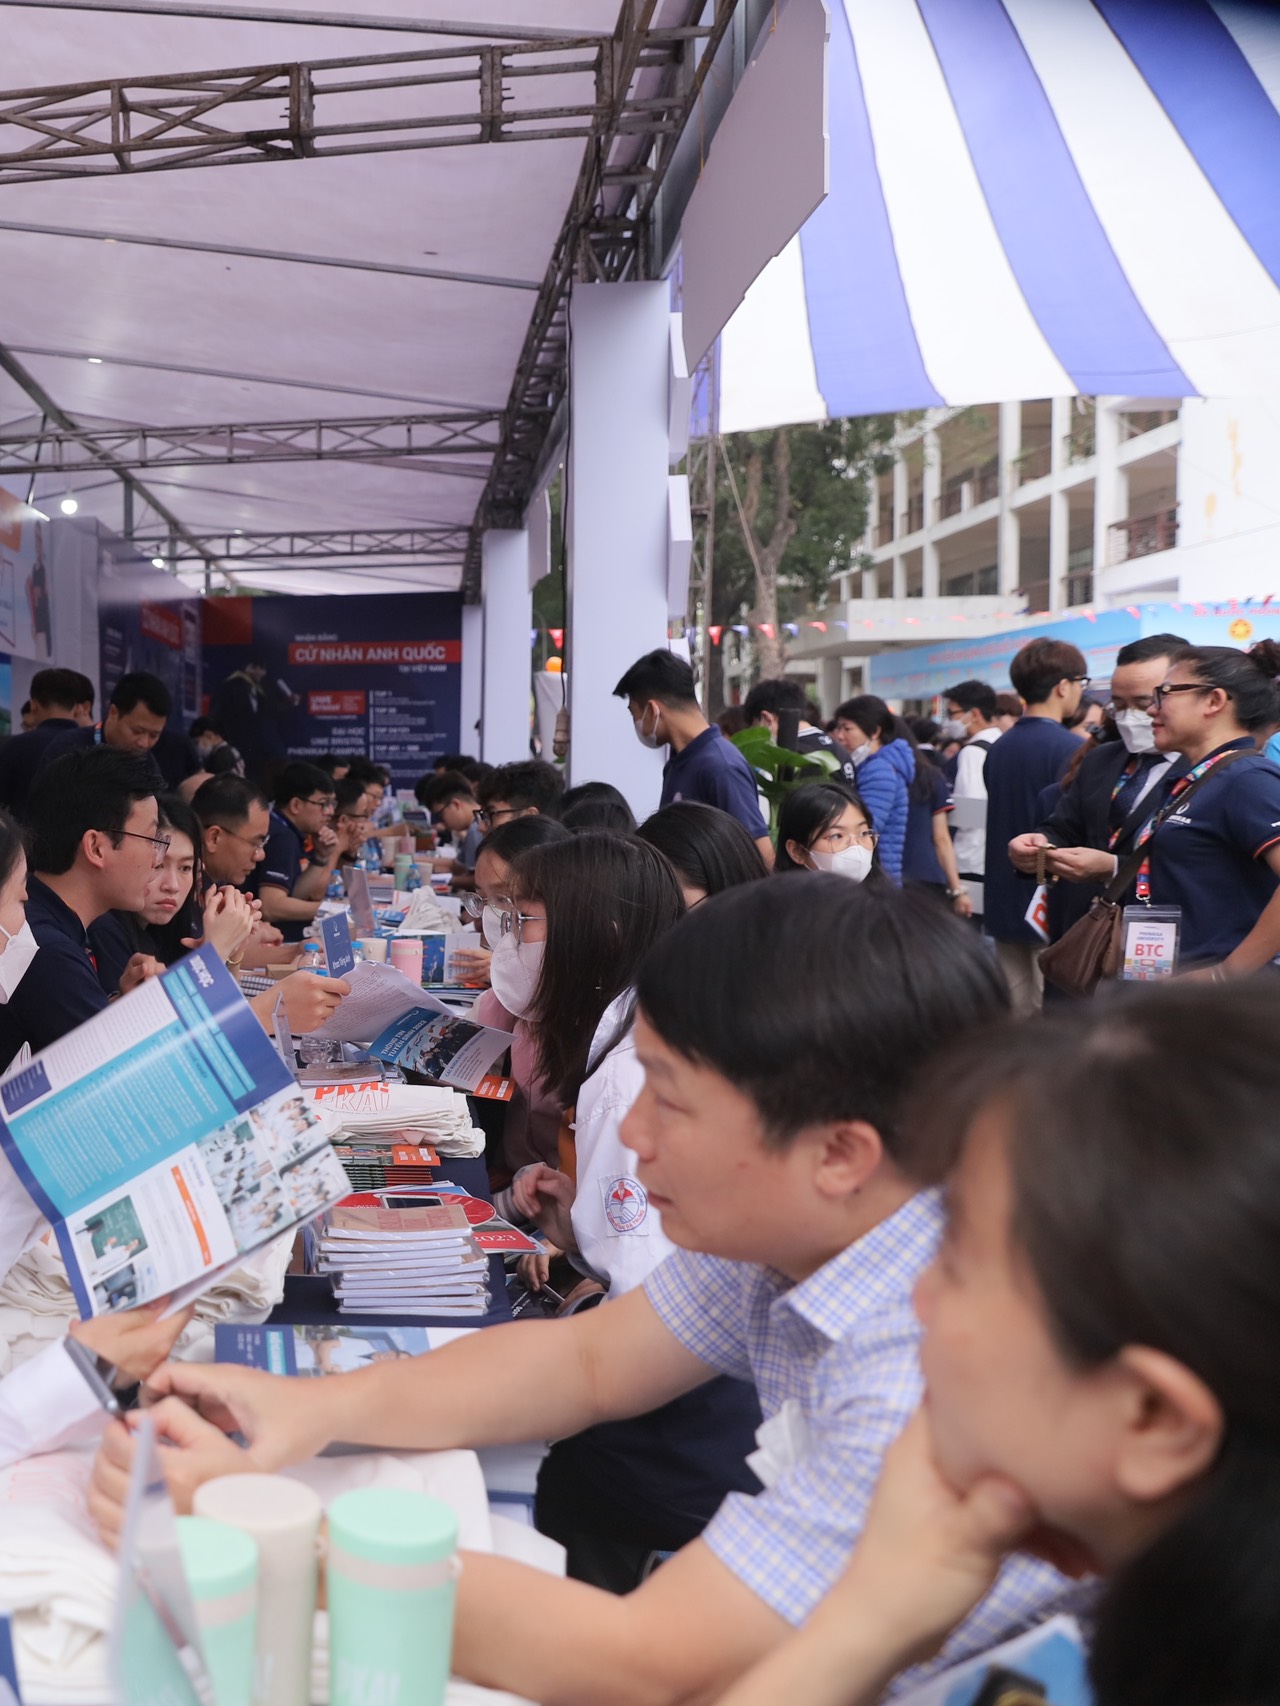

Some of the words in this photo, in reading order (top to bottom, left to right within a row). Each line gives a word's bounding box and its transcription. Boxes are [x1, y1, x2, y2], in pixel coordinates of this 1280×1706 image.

[320, 644, 363, 662] NHÂN
[366, 647, 399, 661] ANH
[1135, 943, 1164, 957] BTC
